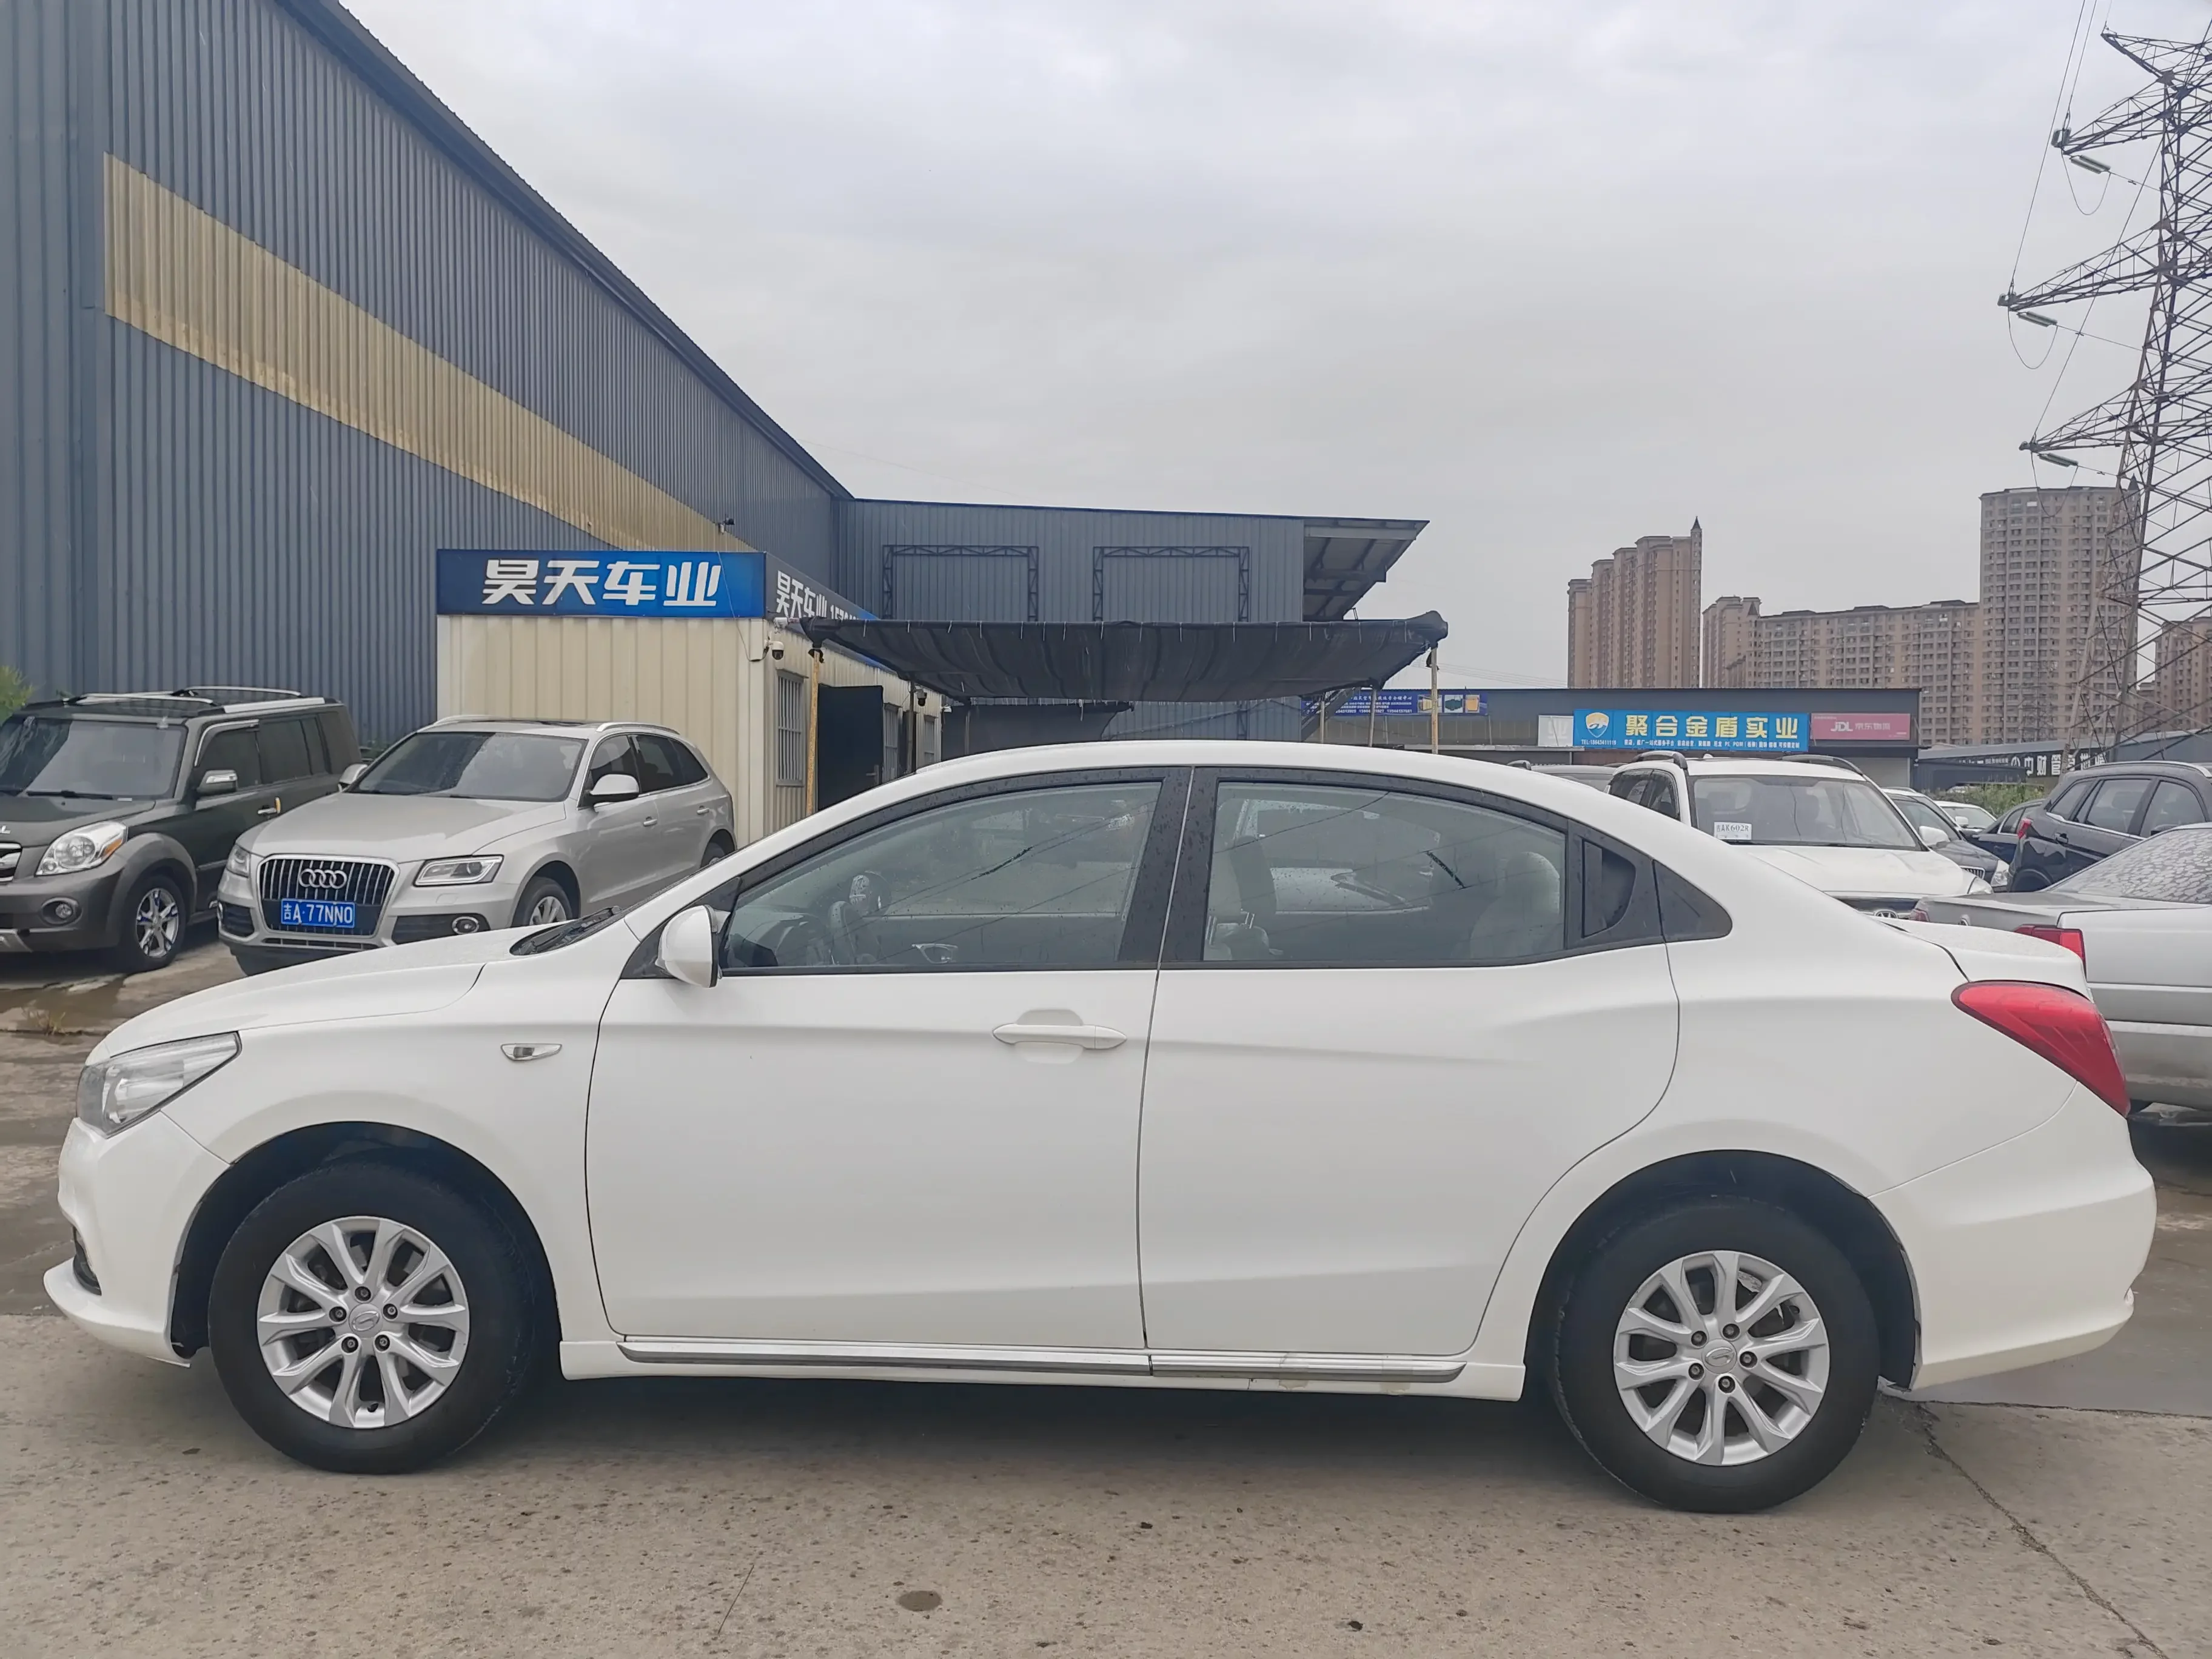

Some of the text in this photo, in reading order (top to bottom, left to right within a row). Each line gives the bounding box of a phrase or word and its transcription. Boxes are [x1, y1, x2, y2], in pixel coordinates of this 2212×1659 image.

[482, 560, 721, 606] 昊天车业
[1626, 715, 1798, 739] 聚合金盾实业
